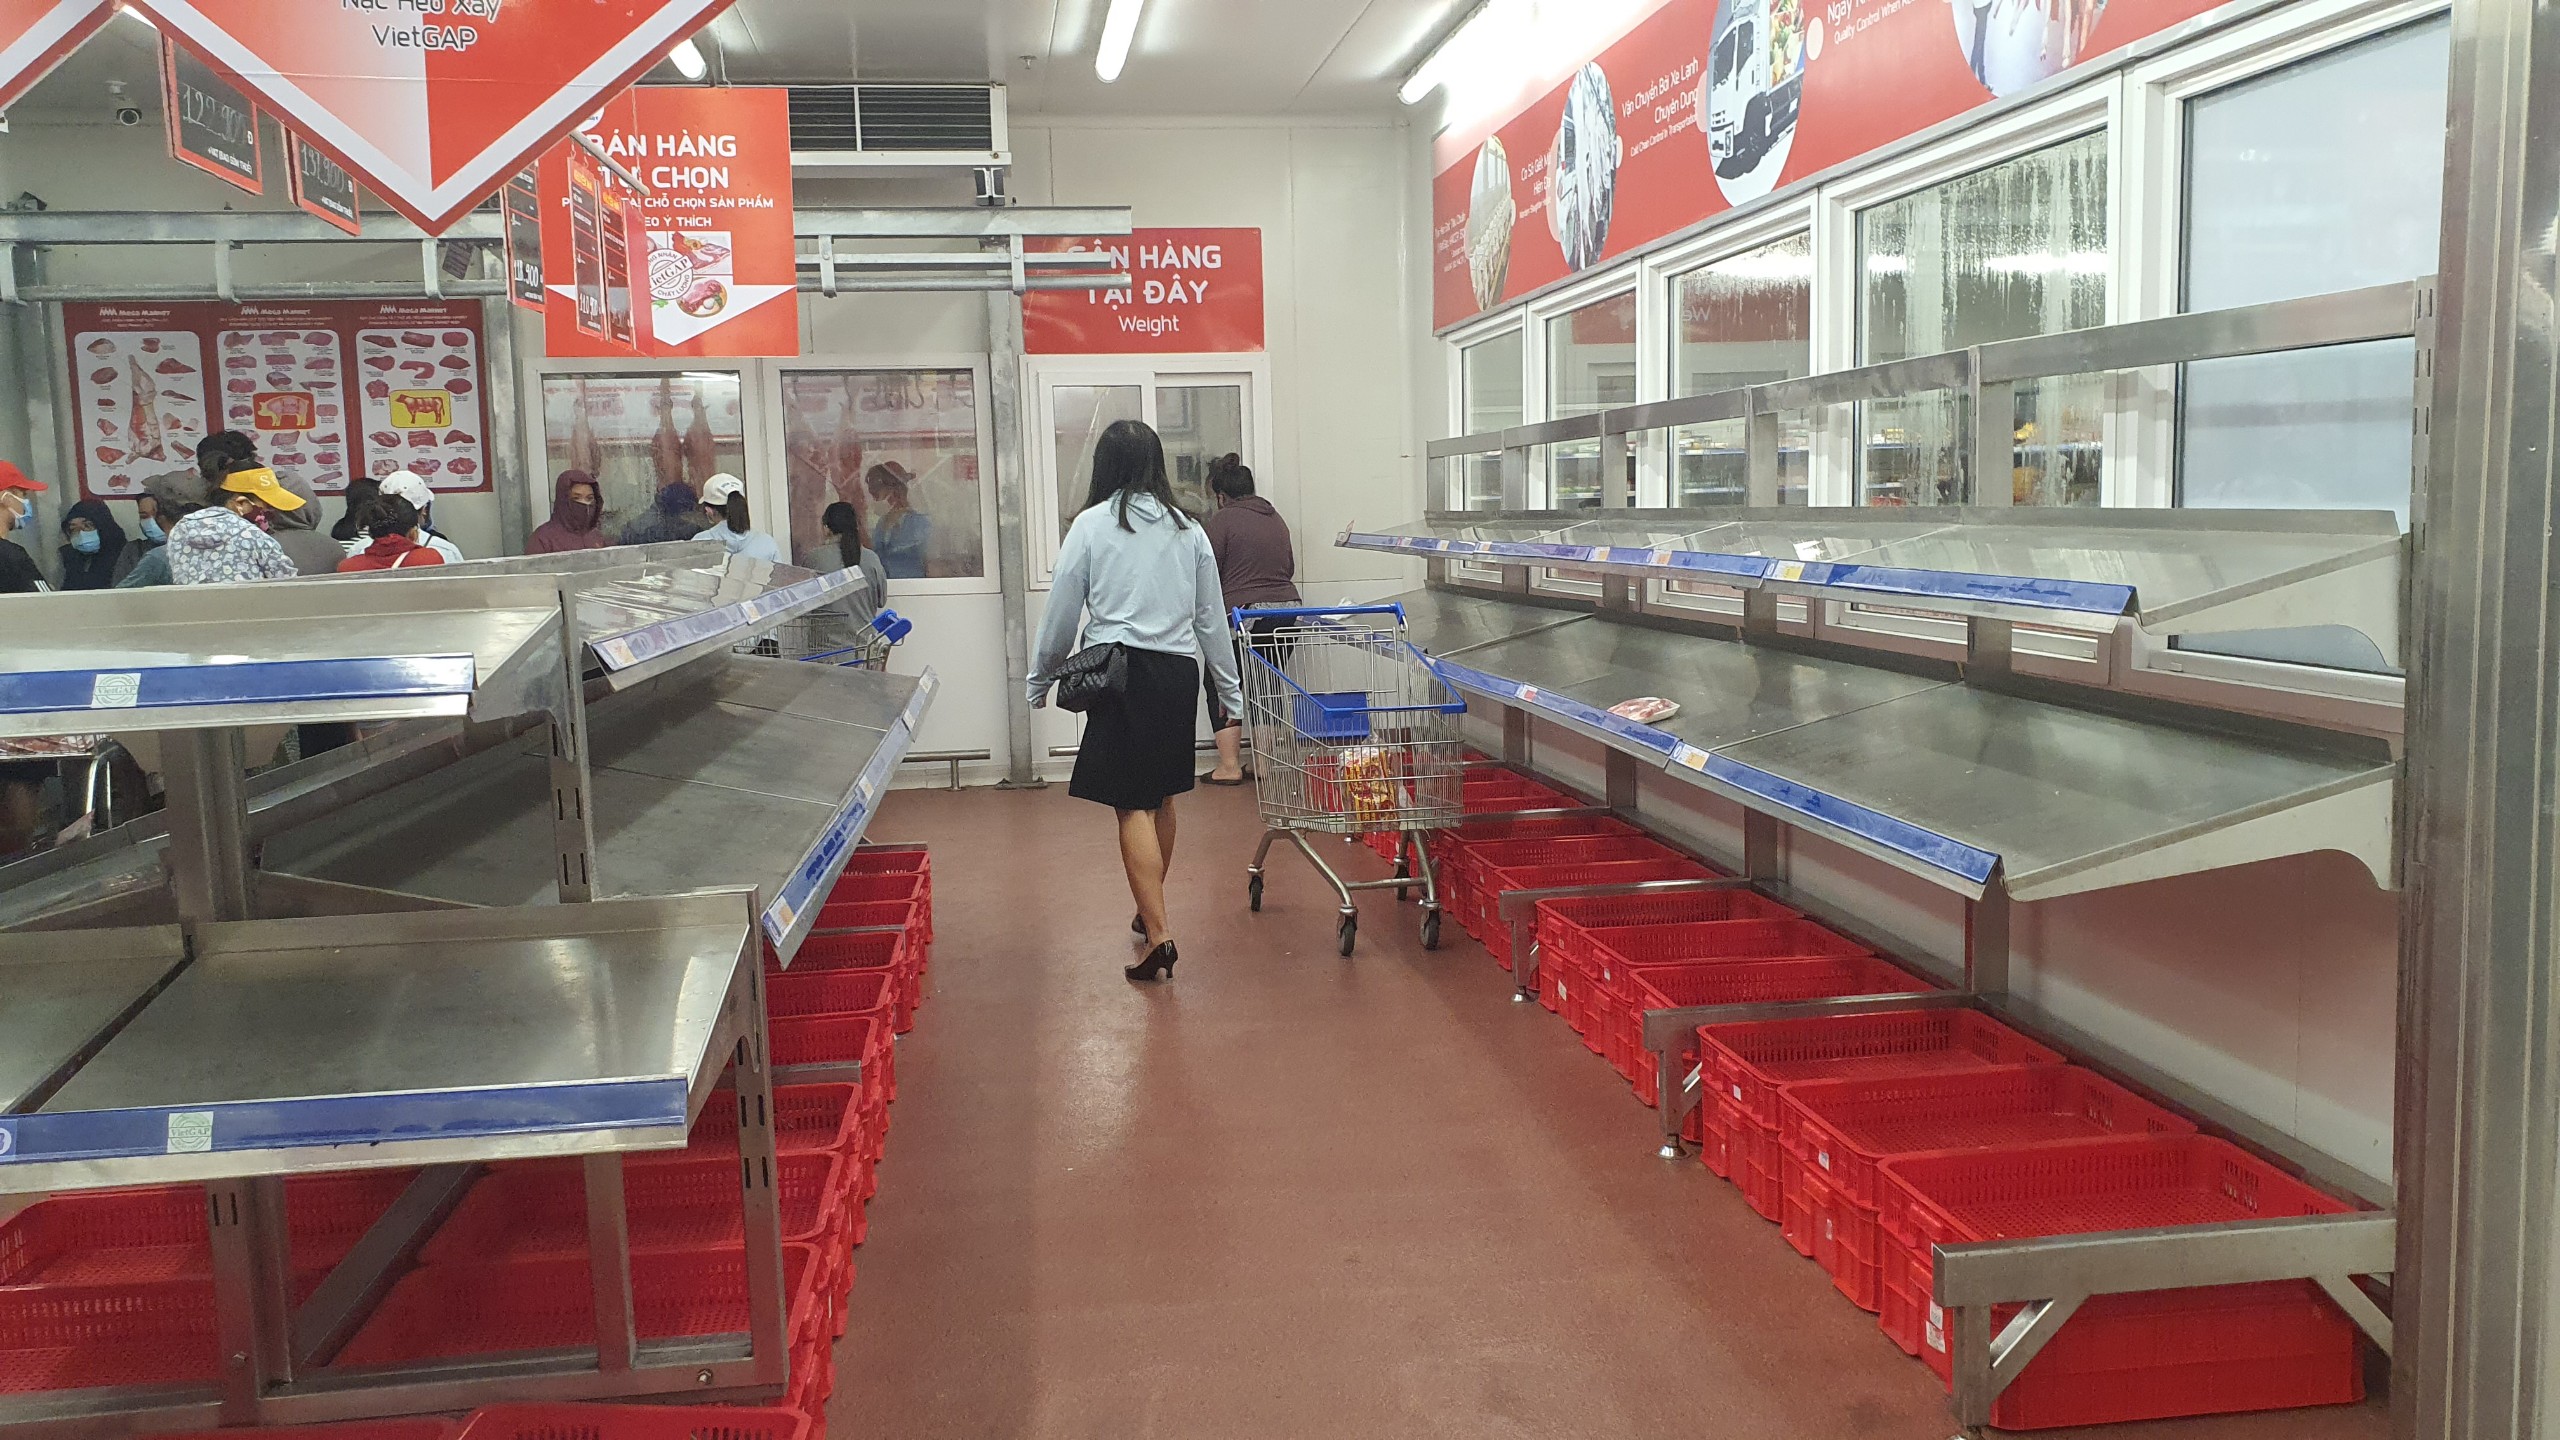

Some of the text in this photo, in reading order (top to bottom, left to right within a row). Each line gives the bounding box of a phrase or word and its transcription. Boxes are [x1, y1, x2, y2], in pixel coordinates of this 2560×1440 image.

[372, 25, 476, 48] VietGAP
[1834, 24, 1855, 45] Quality
[1856, 8, 1880, 32] Control
[1670, 70, 1680, 88] Xe
[656, 129, 738, 157] HÀNG
[652, 166, 730, 194] CHỌN
[644, 192, 670, 208] CHỖ
[673, 197, 706, 210] CHỌN
[710, 194, 736, 208] SẢN
[738, 194, 773, 208] PHẨM
[645, 214, 712, 227] EO Ý THÍCH
[1140, 239, 1222, 269] HÀNG
[651, 258, 688, 286] ietGAP
[1143, 274, 1209, 304] ĐÂY
[1118, 314, 1180, 337] Weight
